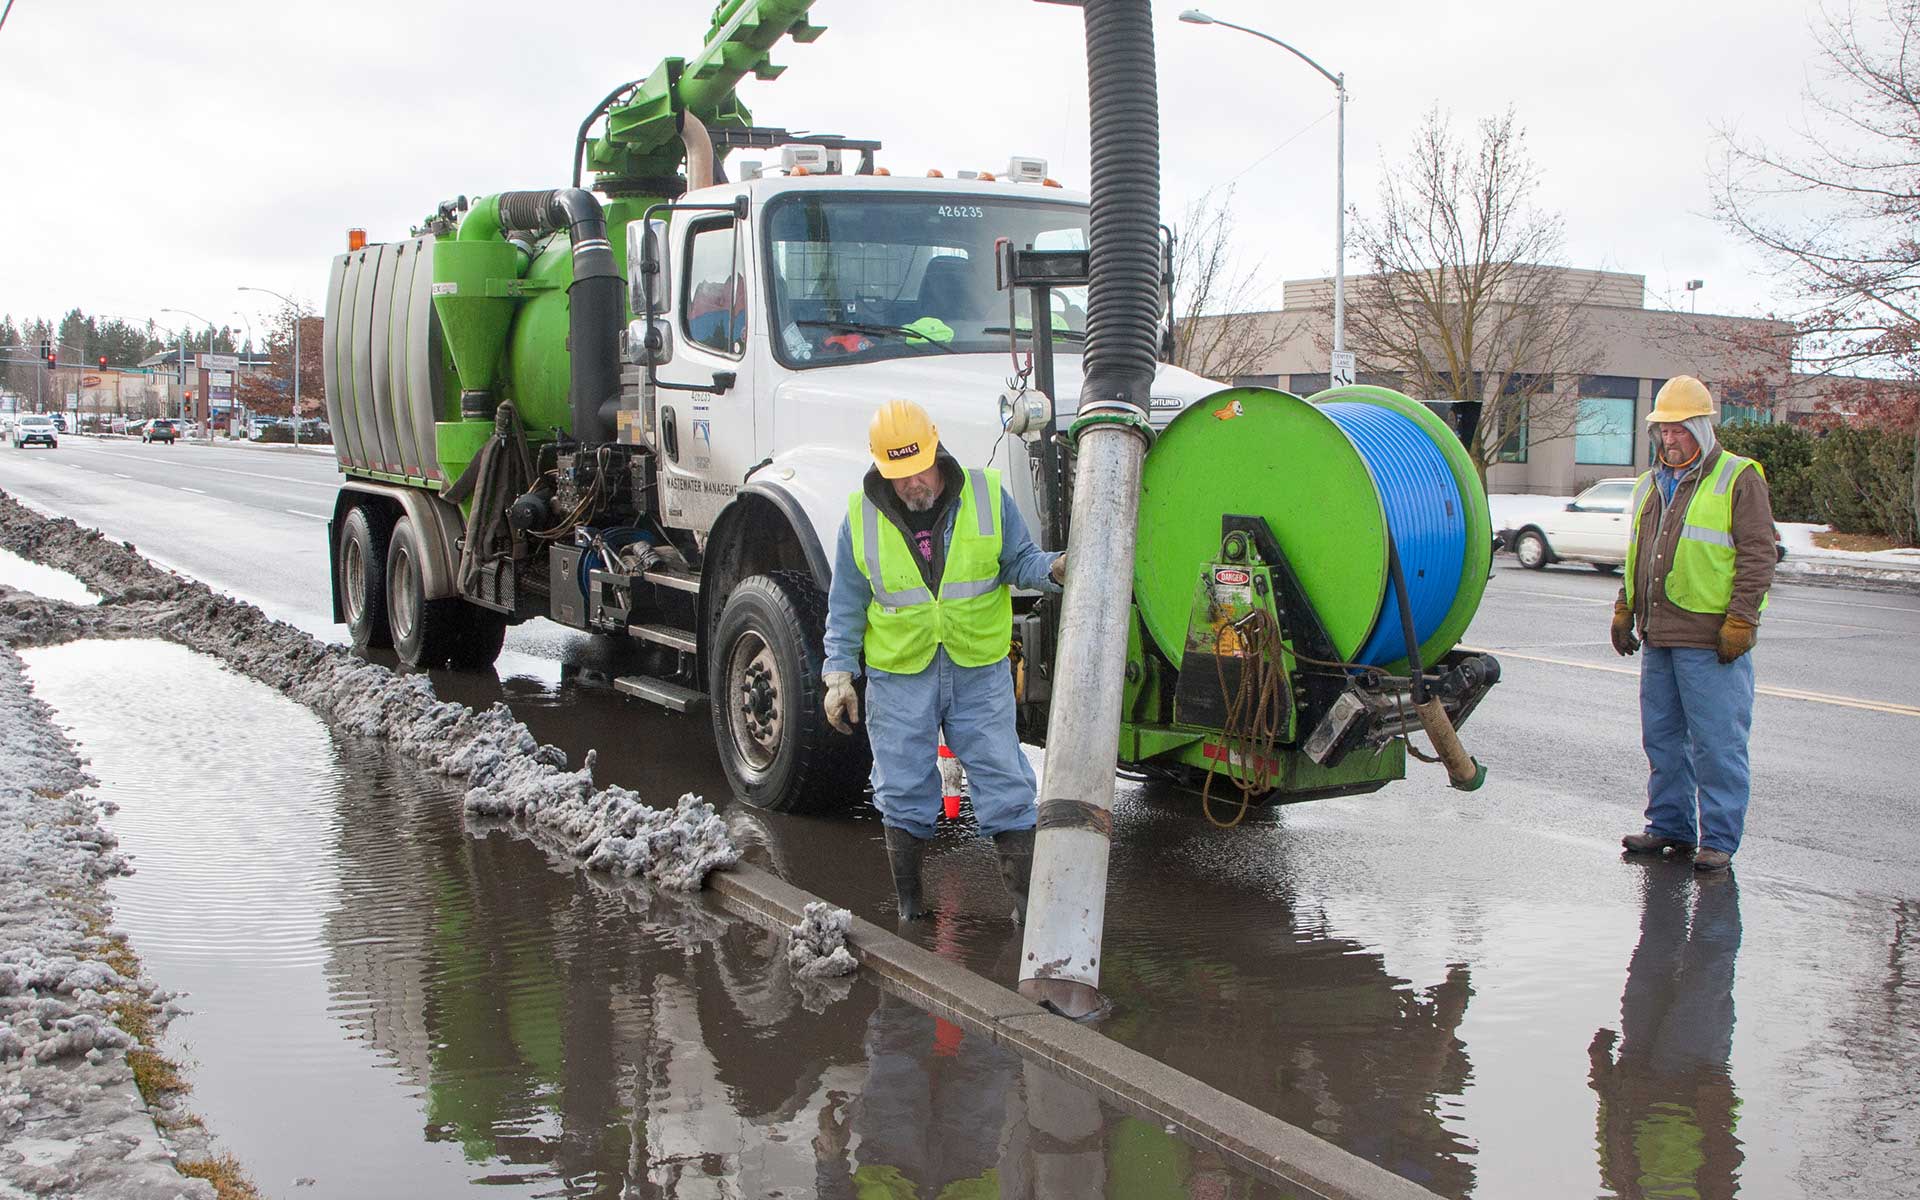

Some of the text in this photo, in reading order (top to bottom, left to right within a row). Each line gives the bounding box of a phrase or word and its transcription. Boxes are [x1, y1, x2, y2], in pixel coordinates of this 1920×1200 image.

[938, 206, 984, 218] 426235
[667, 478, 738, 497] WASTEWATER MANAGEME
[1221, 572, 1243, 580] DANGER
